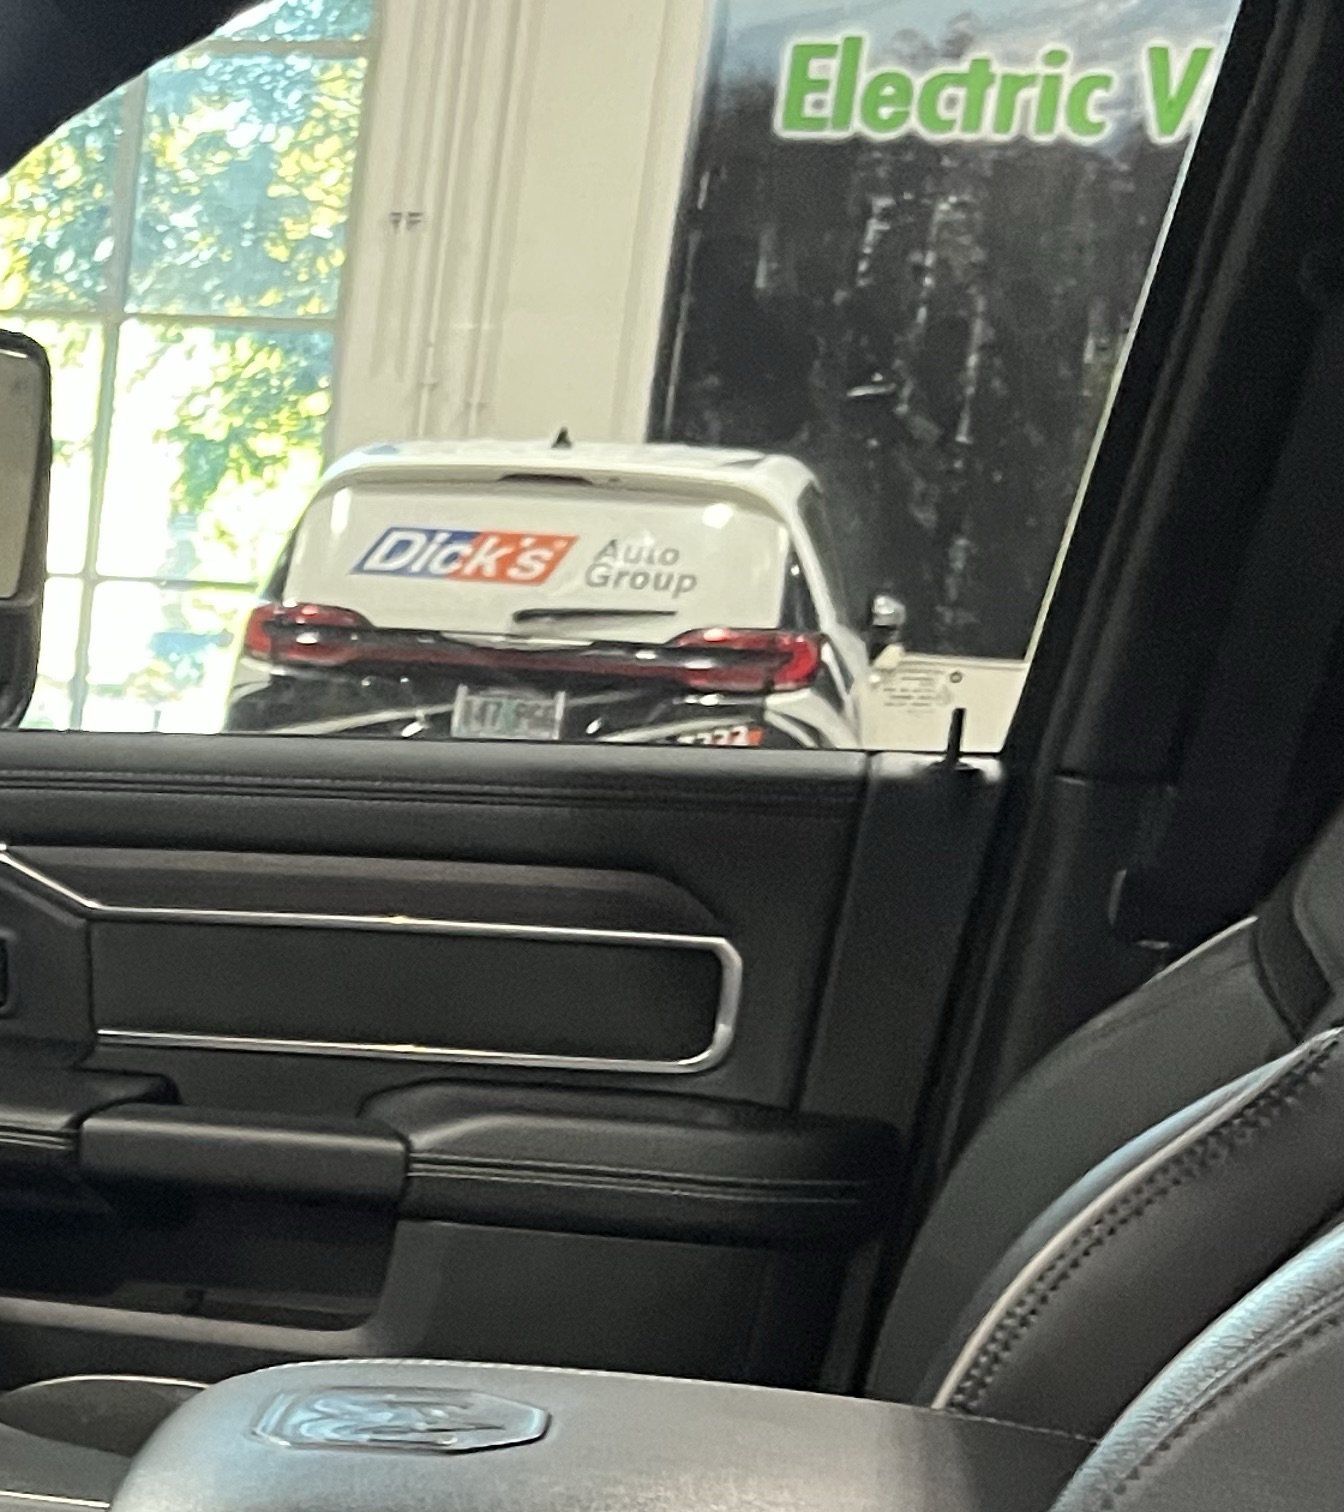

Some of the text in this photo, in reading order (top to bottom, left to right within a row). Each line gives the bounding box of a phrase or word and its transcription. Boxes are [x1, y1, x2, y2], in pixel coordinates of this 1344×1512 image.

[777, 34, 1115, 137] Electric
[593, 538, 681, 567] Auto
[584, 562, 698, 599] Group
